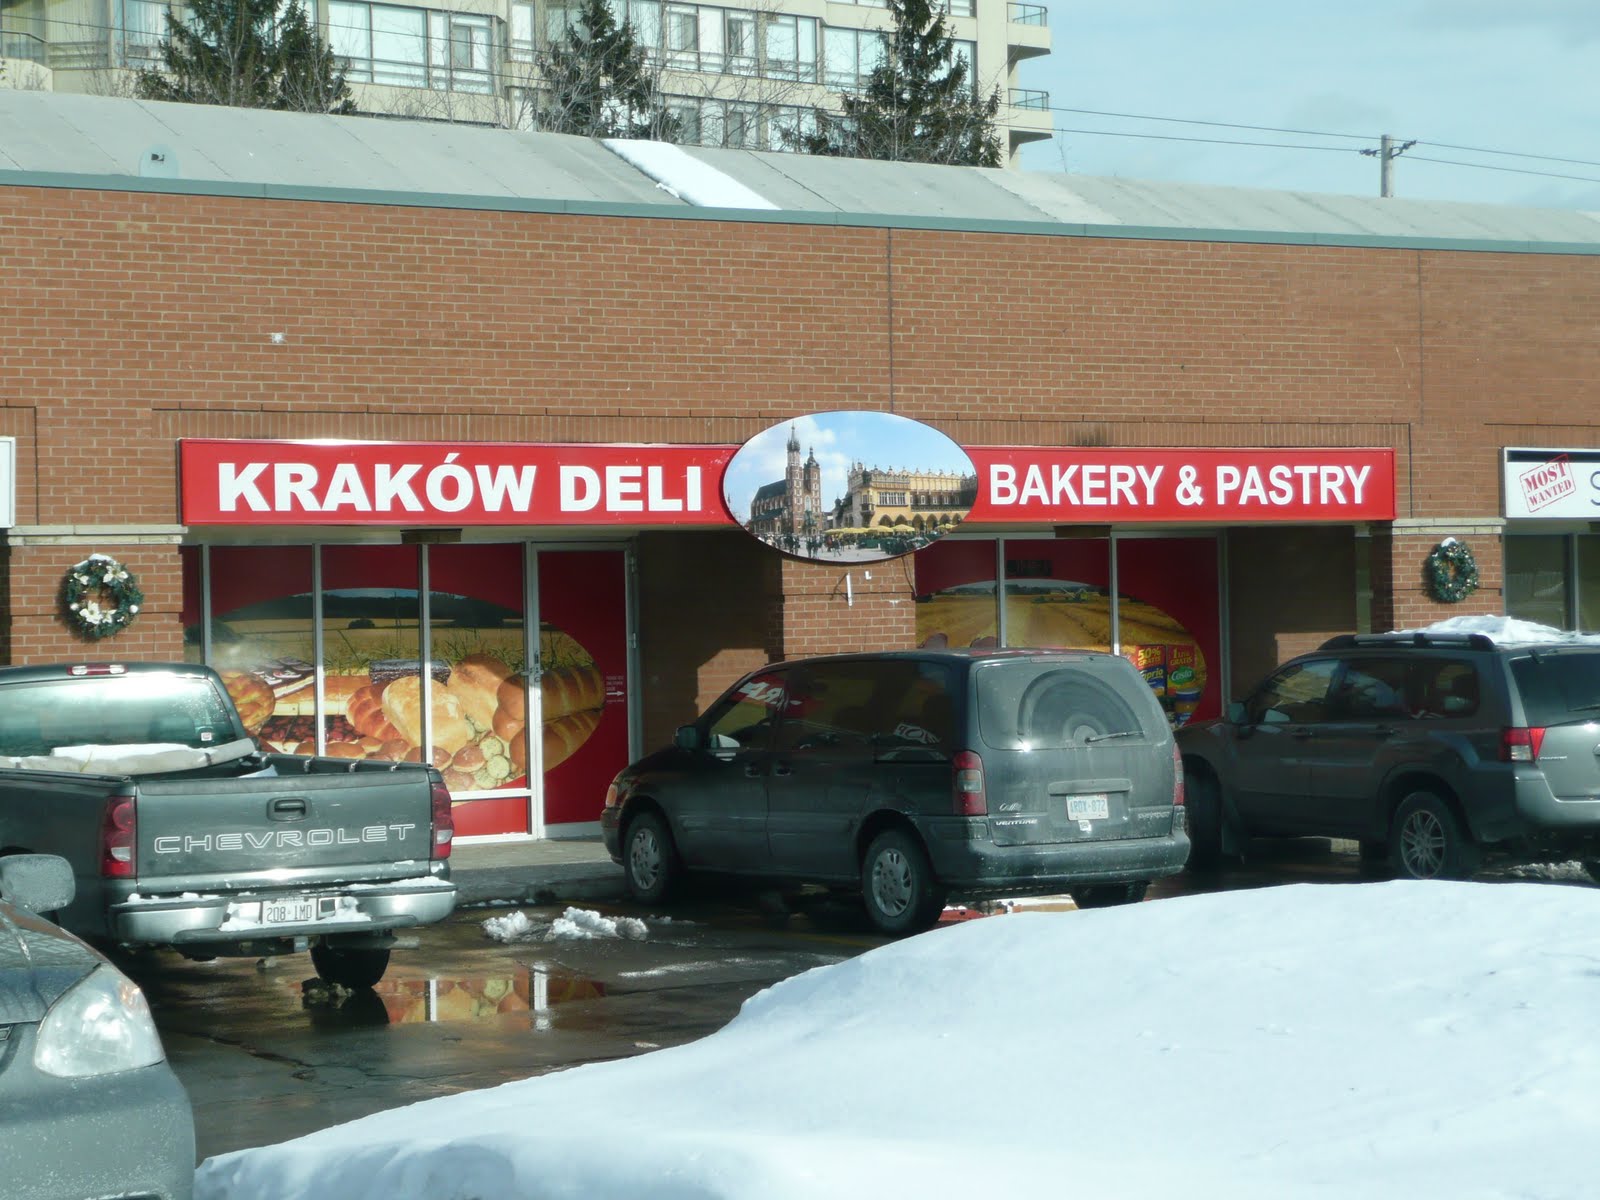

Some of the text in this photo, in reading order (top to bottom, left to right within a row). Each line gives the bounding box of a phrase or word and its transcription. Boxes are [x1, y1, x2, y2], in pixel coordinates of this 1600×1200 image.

[217, 452, 703, 513] KRAKÓW DELI
[989, 463, 1371, 506] BAKERY & PASTRY
[1523, 461, 1567, 493] MOST
[1528, 479, 1573, 507] WANTED
[1137, 646, 1161, 661] 50%
[1170, 656, 1193, 666] GRATIS
[1171, 669, 1193, 681] Costa
[153, 823, 416, 854] CHEVROLET
[266, 906, 287, 921] 208
